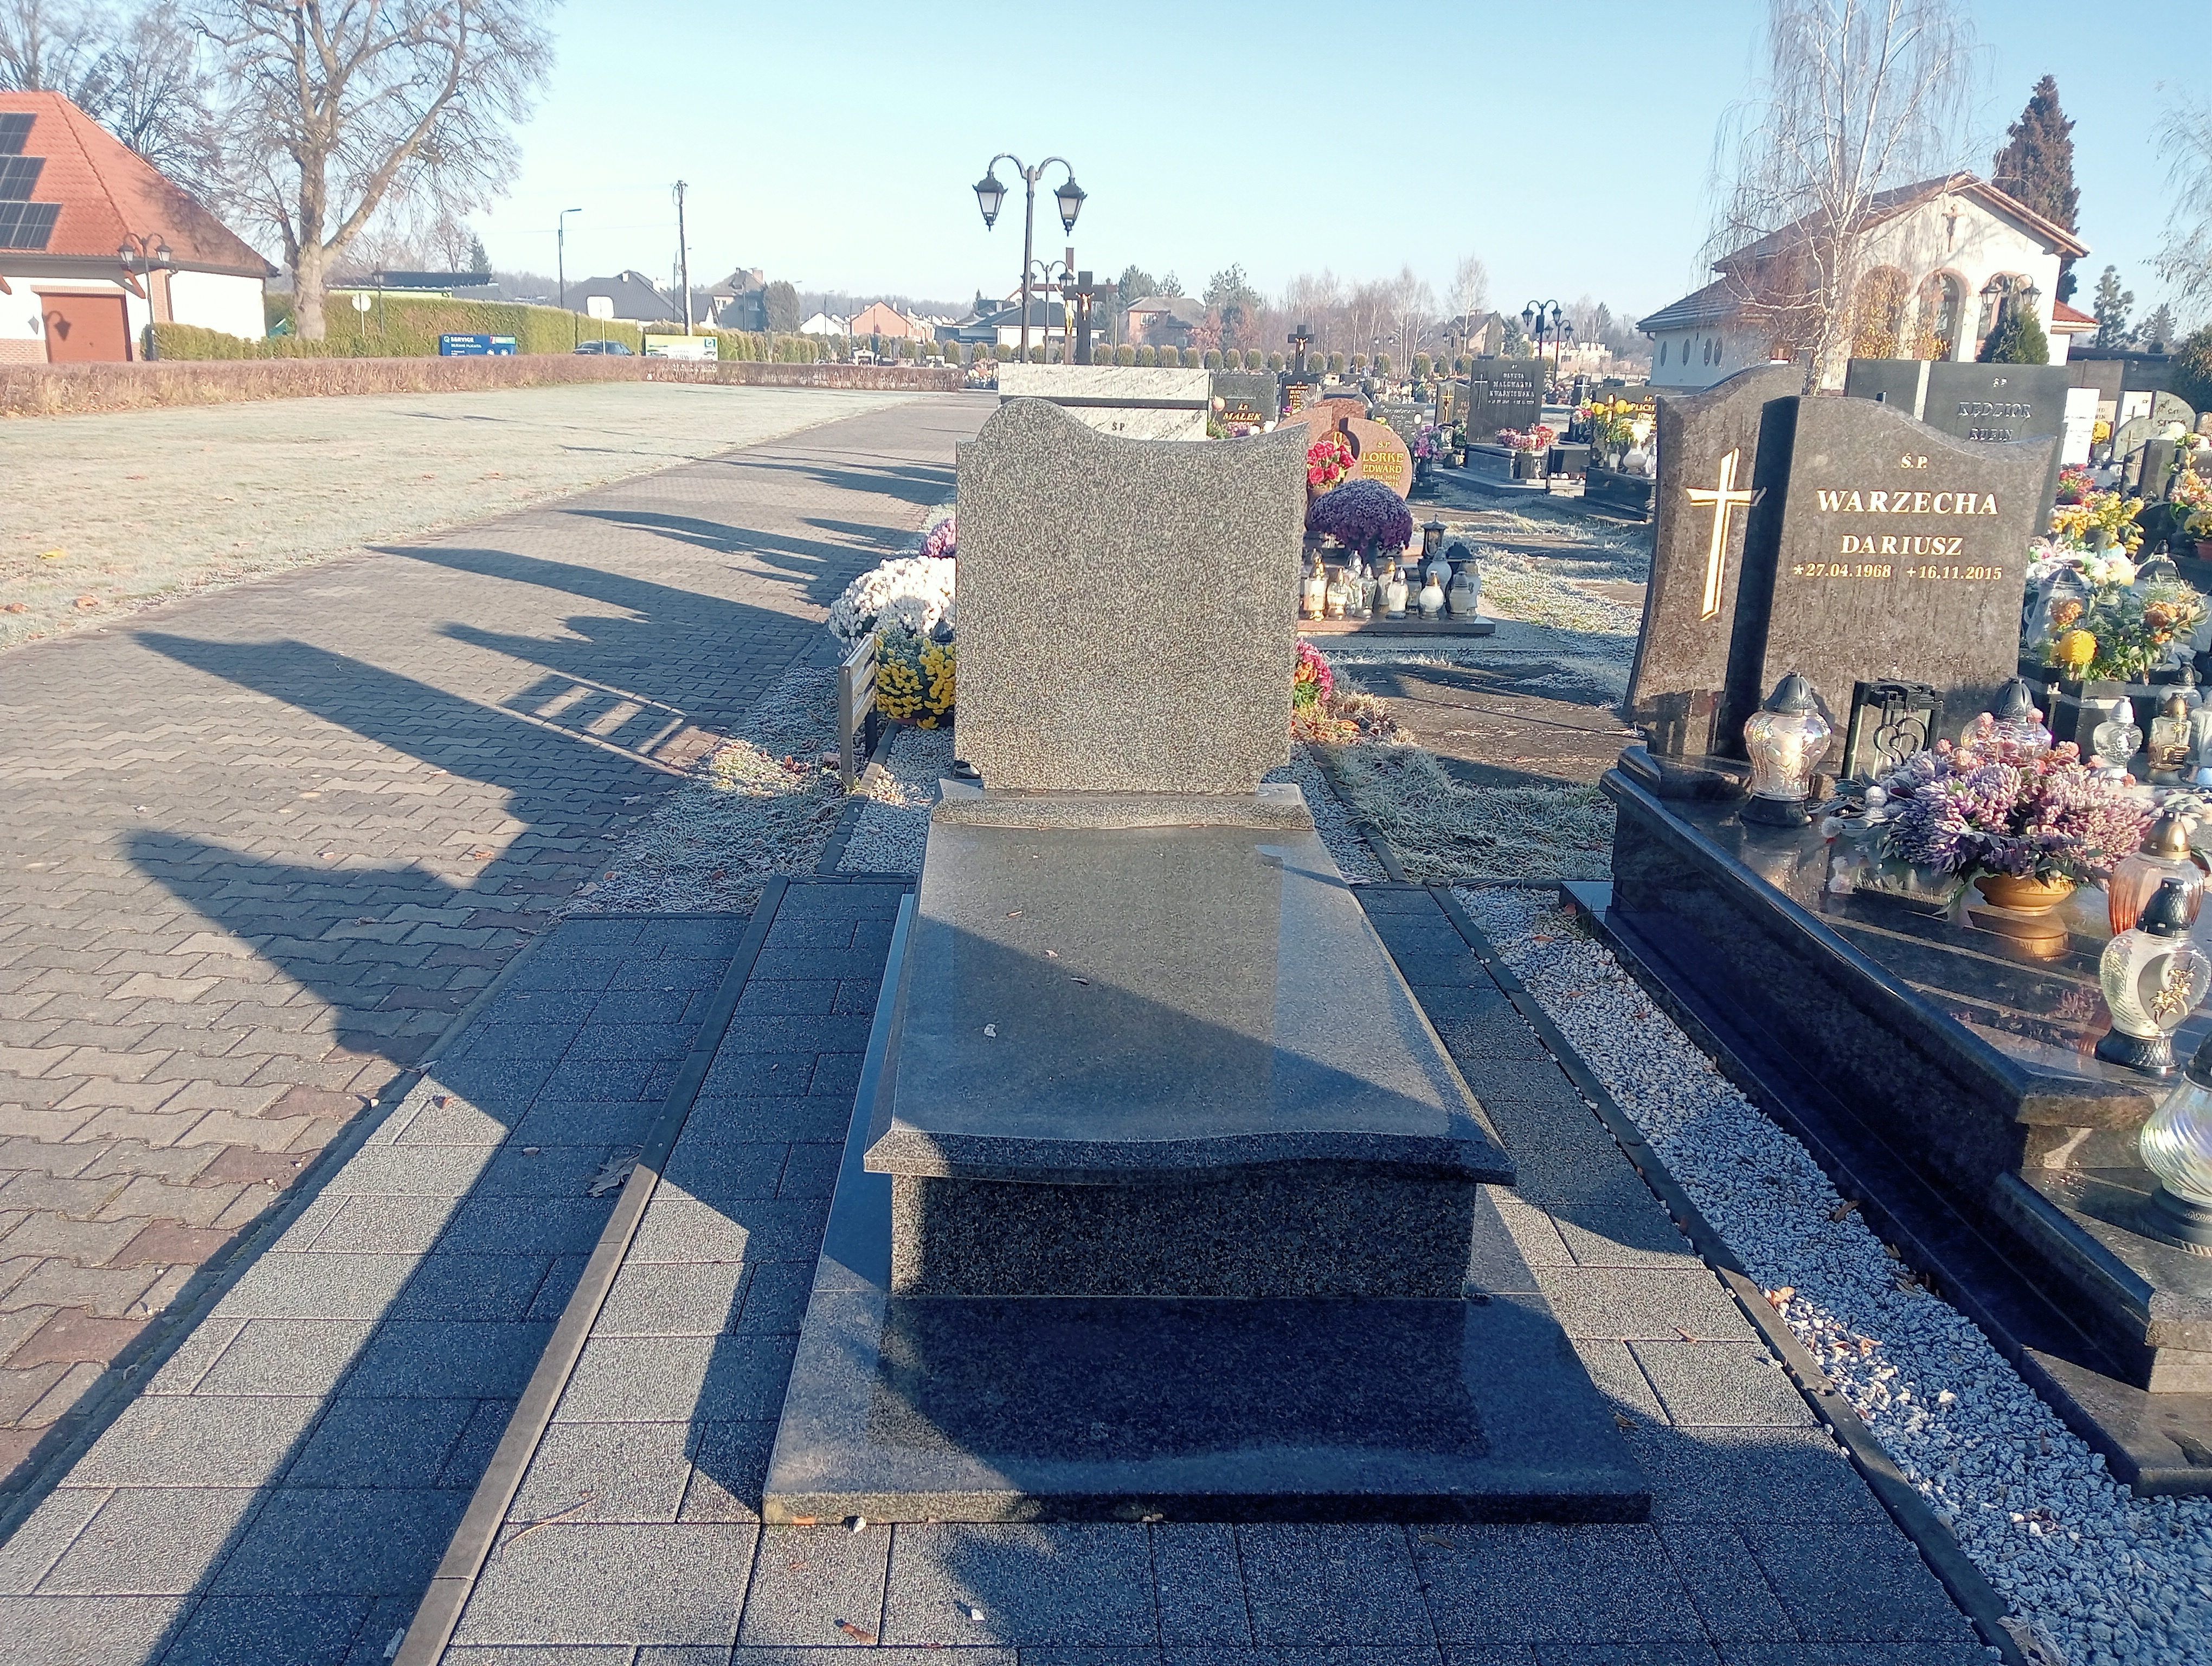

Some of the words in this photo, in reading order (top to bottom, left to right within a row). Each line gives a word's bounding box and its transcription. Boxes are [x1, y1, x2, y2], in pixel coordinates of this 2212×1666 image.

[1631, 403, 1656, 411] PLICH
[1223, 412, 1262, 420] MALEK
[1362, 452, 1404, 463] LORKE
[1363, 464, 1403, 473] EDWARD
[1817, 490, 1998, 515] WARZECHA
[1841, 535, 1964, 556] DARIUSZ
